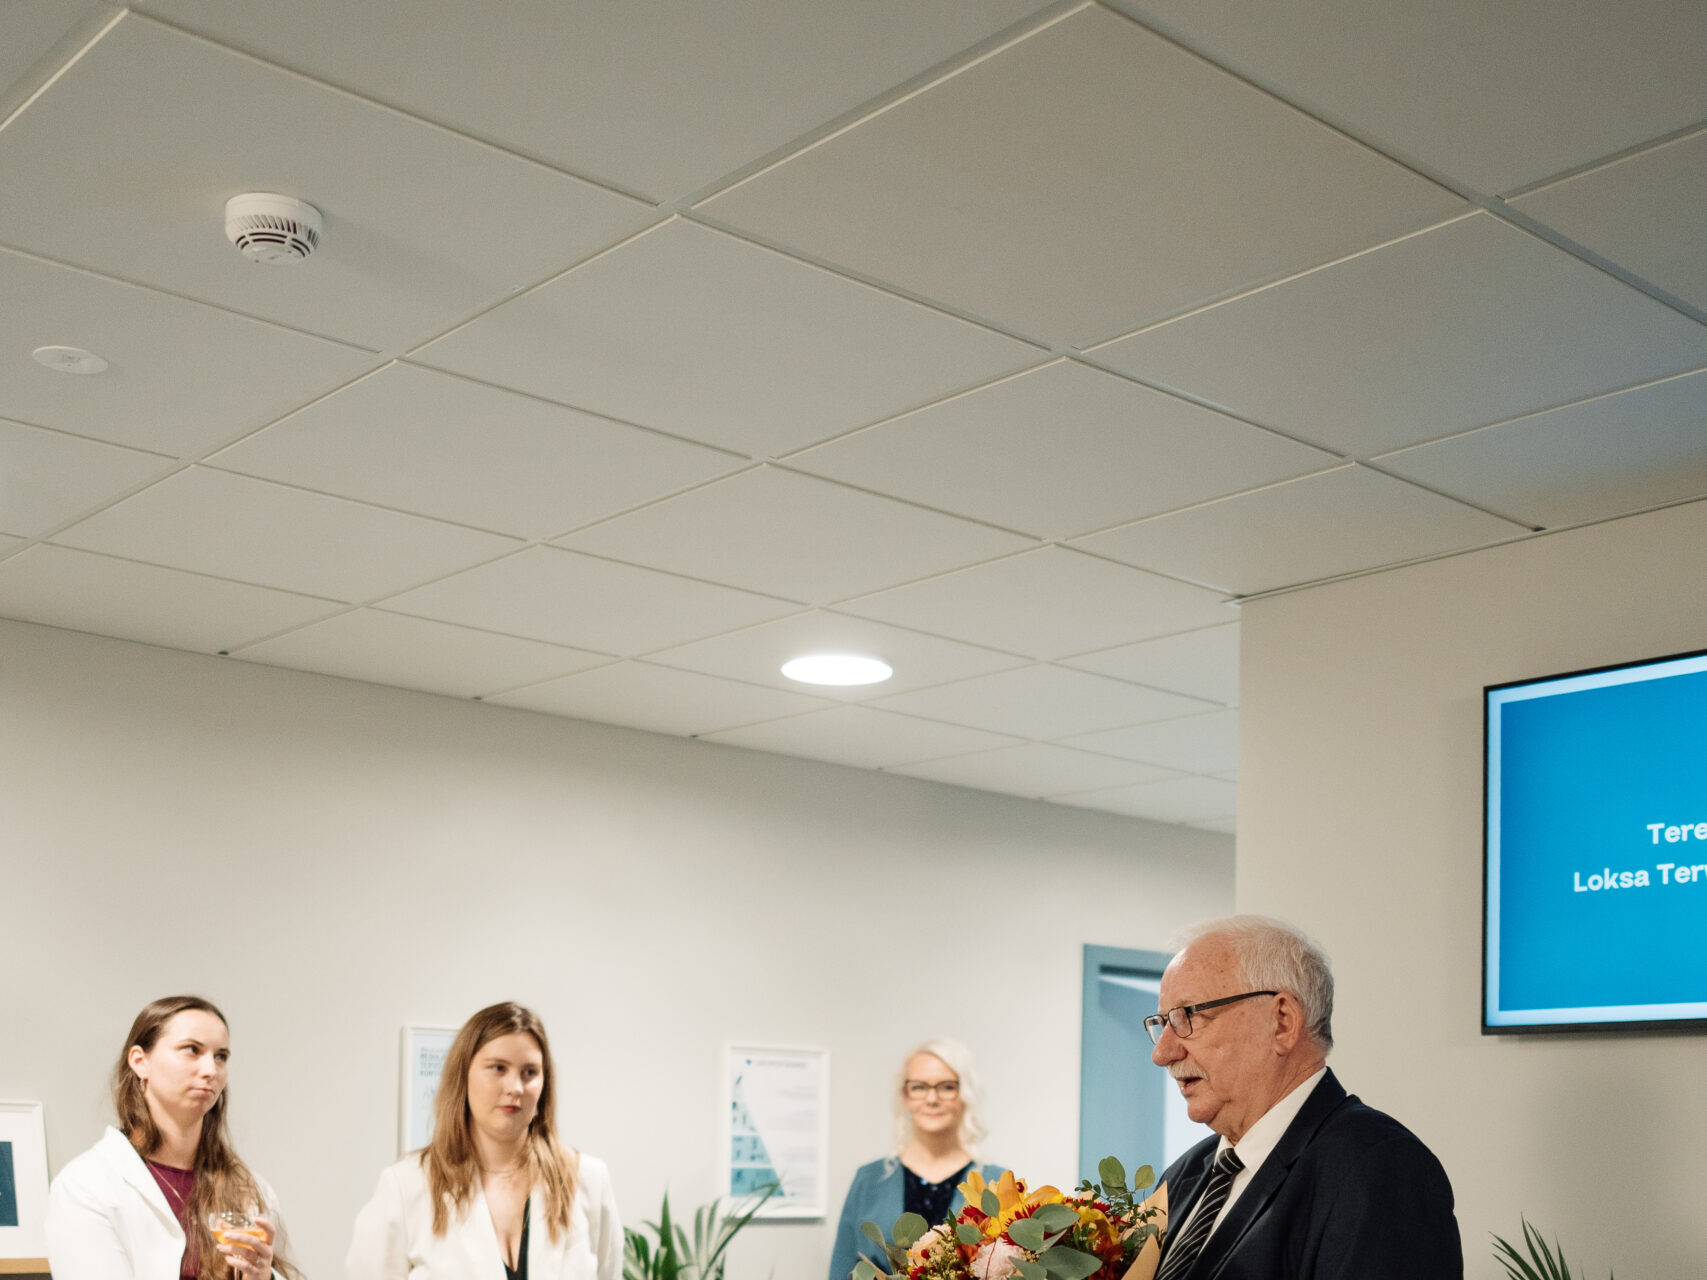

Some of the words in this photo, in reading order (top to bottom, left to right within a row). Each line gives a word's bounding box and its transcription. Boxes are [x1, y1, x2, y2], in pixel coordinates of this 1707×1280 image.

[1646, 822, 1707, 845] Tere
[1573, 867, 1651, 893] Loksa
[1656, 862, 1707, 885] Ter
